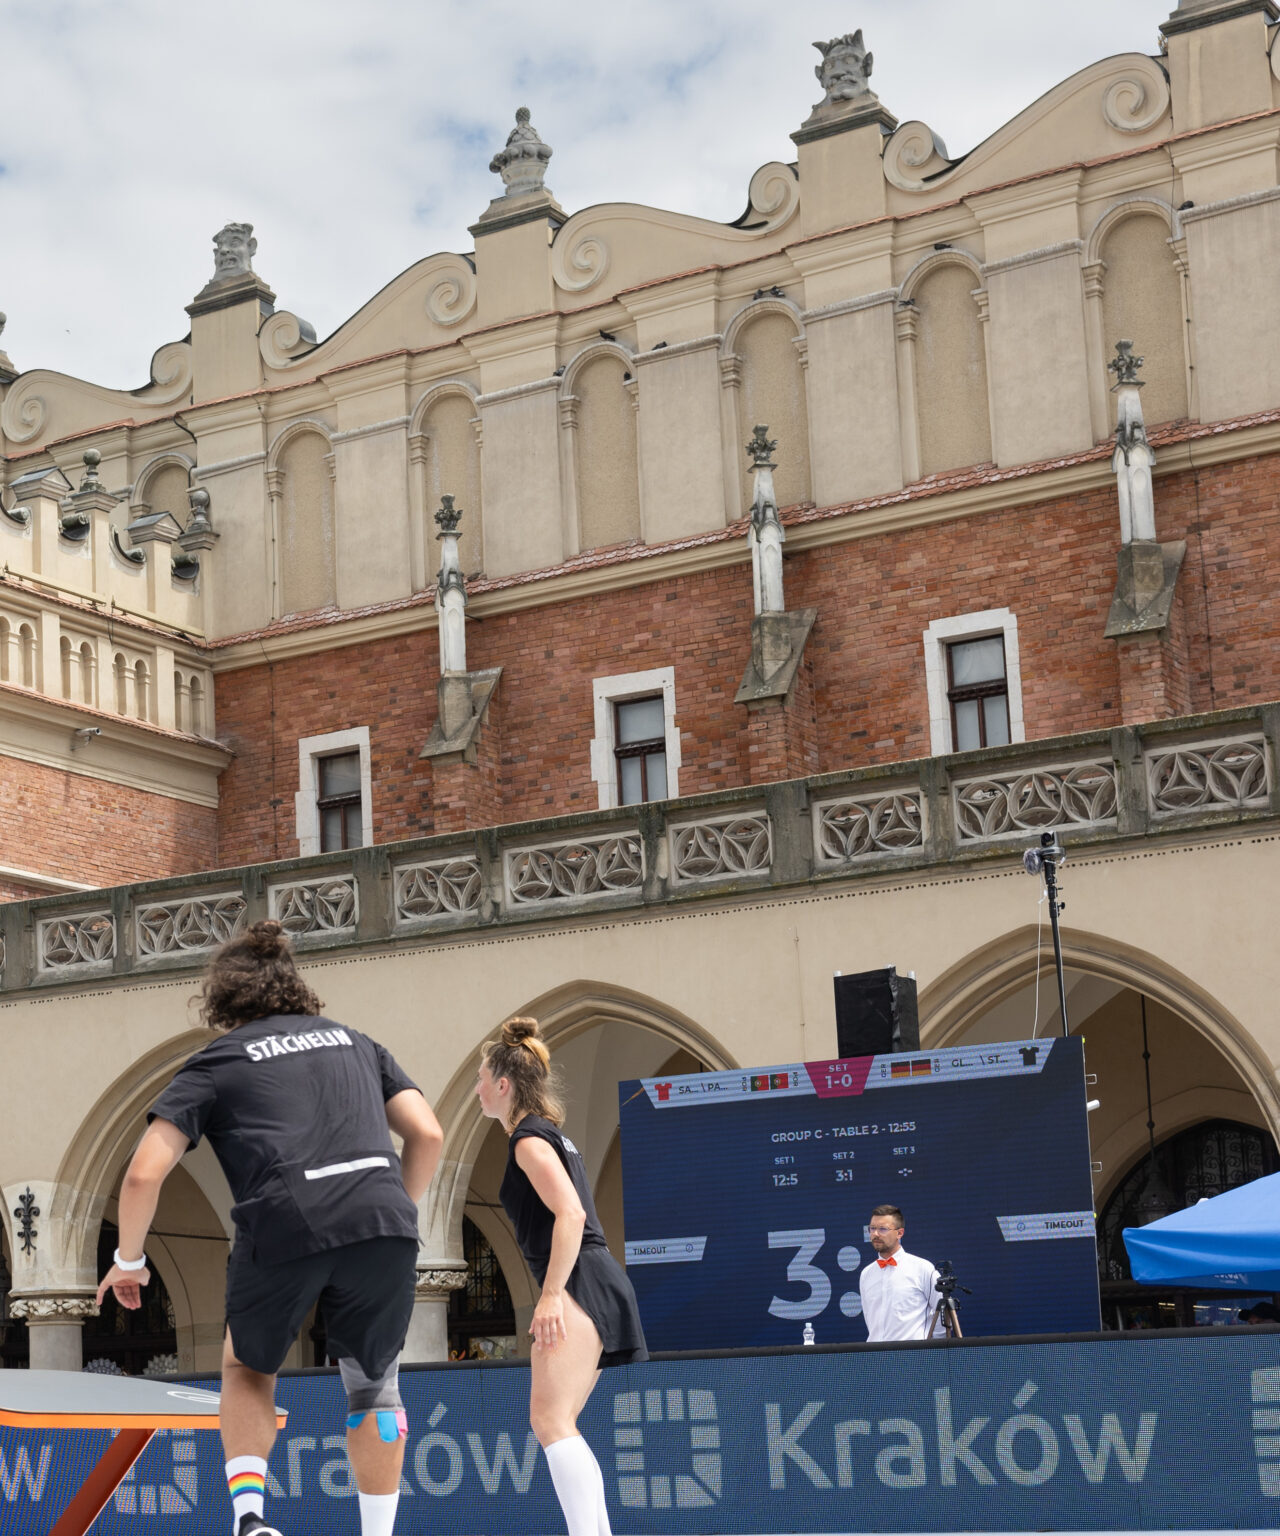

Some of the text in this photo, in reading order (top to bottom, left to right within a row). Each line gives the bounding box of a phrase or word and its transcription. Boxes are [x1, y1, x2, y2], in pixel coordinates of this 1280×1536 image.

[246, 1029, 353, 1061] STÄCHELIN
[828, 1063, 848, 1073] SET
[824, 1073, 853, 1089] 1-0
[771, 1130, 812, 1143] GROUP
[814, 1129, 823, 1139] C
[831, 1125, 869, 1138] TABLE
[871, 1124, 879, 1135] 2
[888, 1121, 917, 1133] 12:55
[832, 1151, 855, 1160] SET 2
[892, 1146, 916, 1155] SET 3
[774, 1155, 795, 1165] SET 1
[772, 1173, 799, 1187] 12:5
[835, 1169, 853, 1182] 3:1
[1044, 1219, 1084, 1230] TIMEOUT
[633, 1246, 667, 1256] TIMEOUT
[765, 1379, 1159, 1490] Kraków
